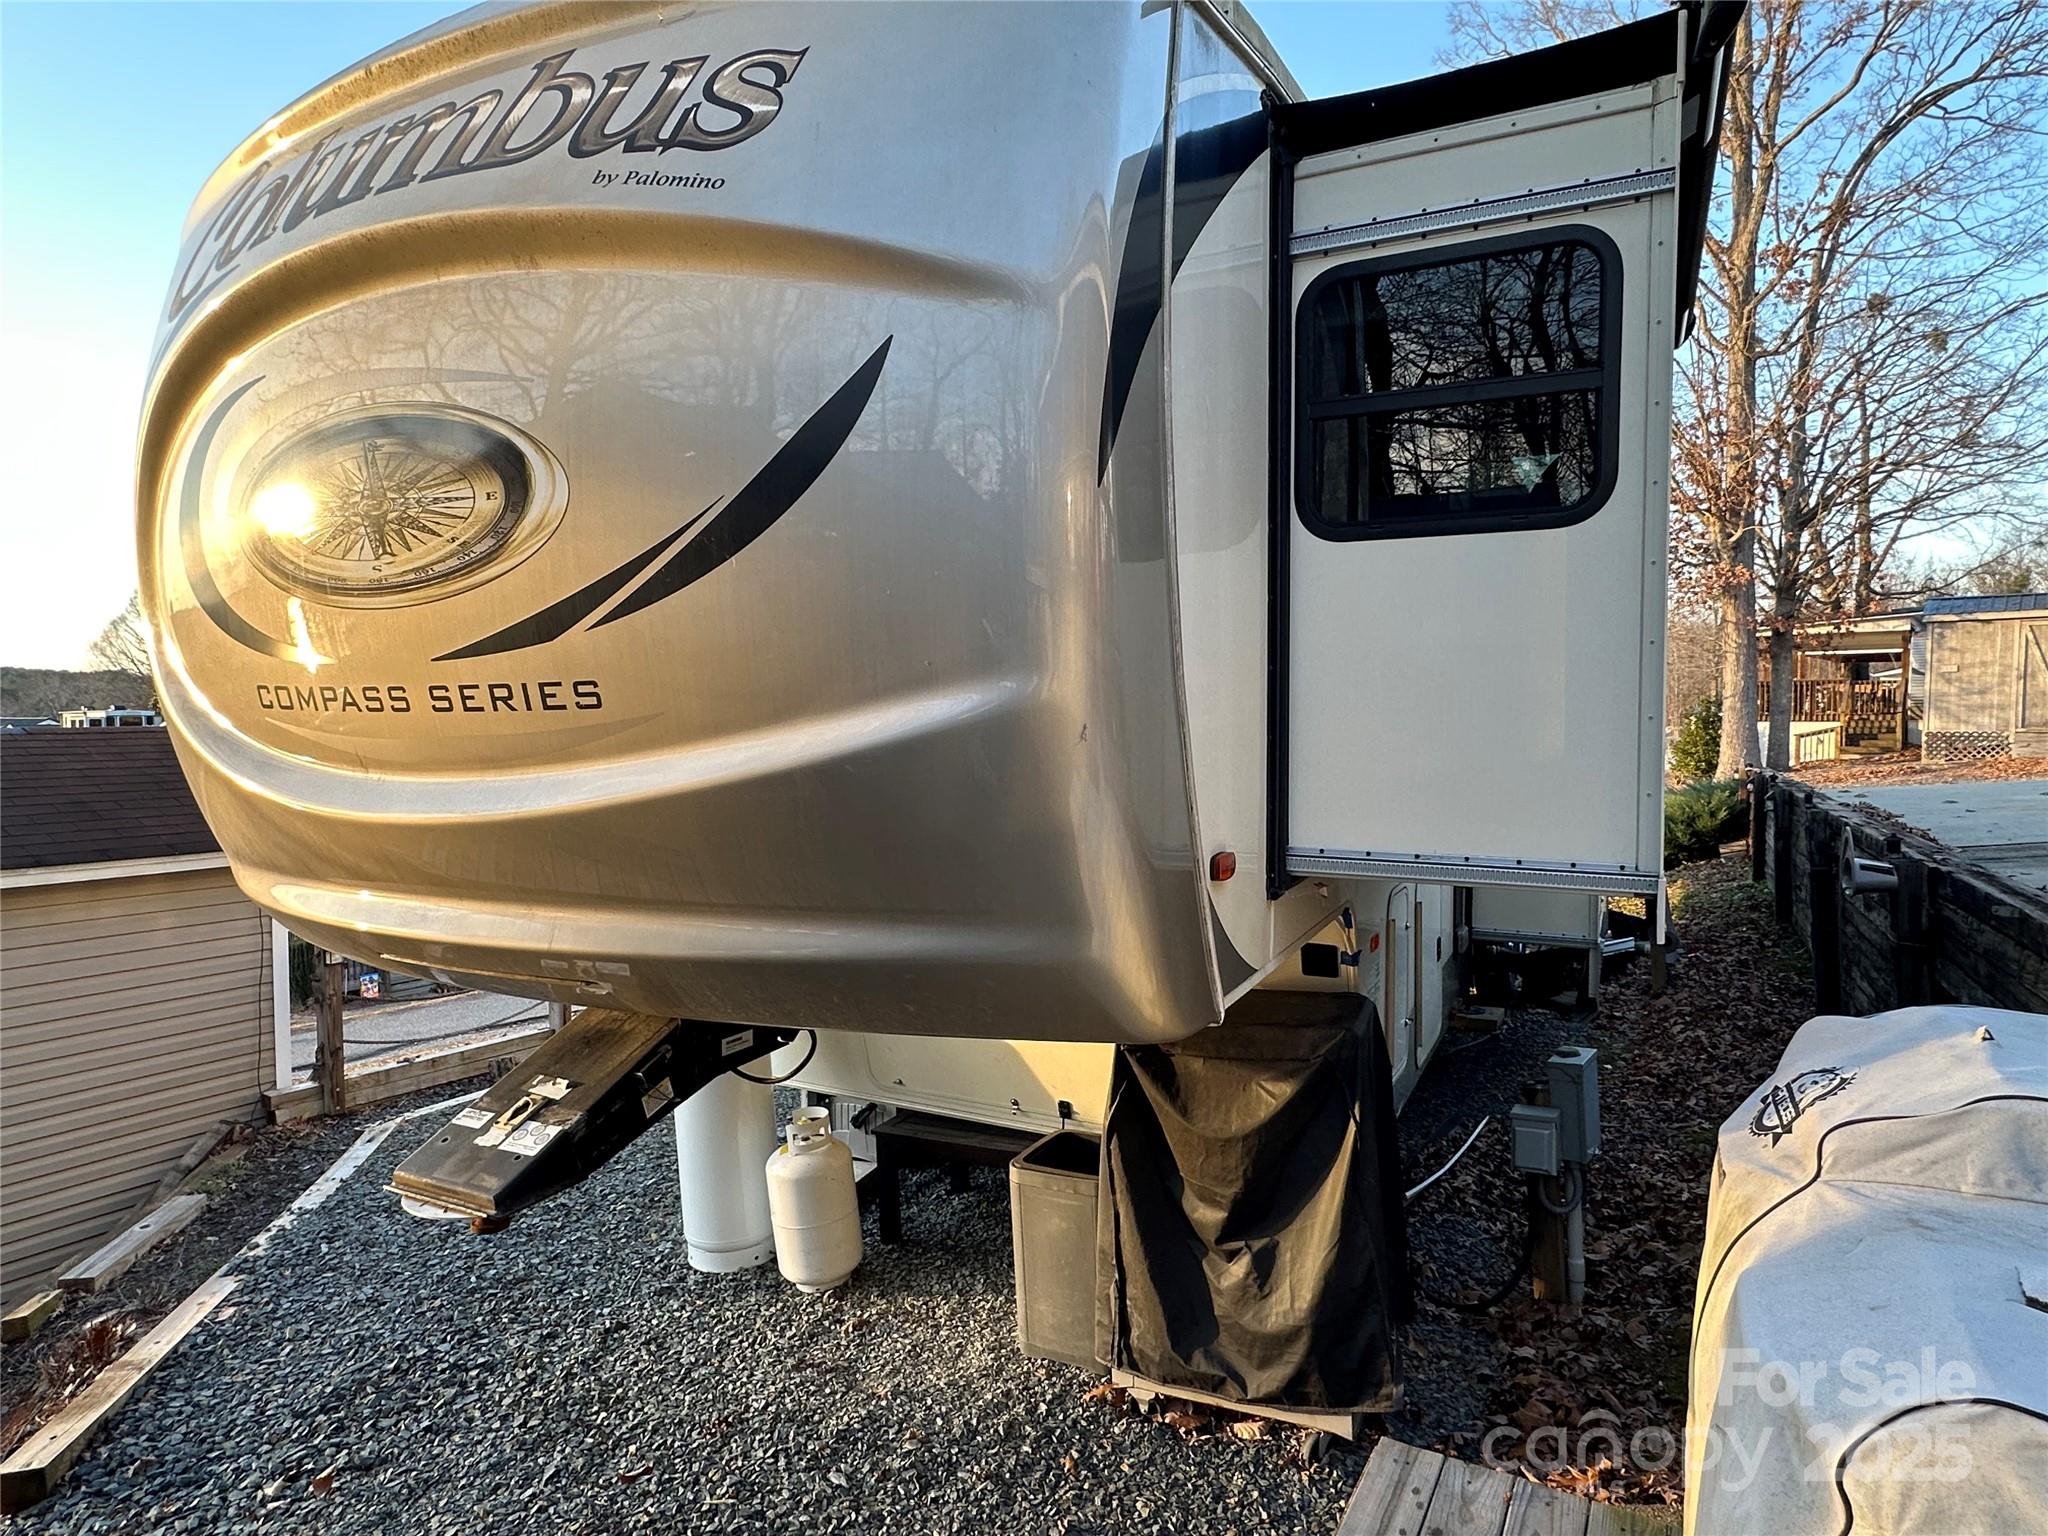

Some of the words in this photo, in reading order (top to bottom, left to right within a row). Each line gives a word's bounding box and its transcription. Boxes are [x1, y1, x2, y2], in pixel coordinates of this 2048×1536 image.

[167, 46, 811, 323] Columbus
[592, 170, 619, 188] by
[622, 171, 725, 189] Palomino
[256, 684, 411, 713] COMPASS
[428, 679, 603, 713] SERIES
